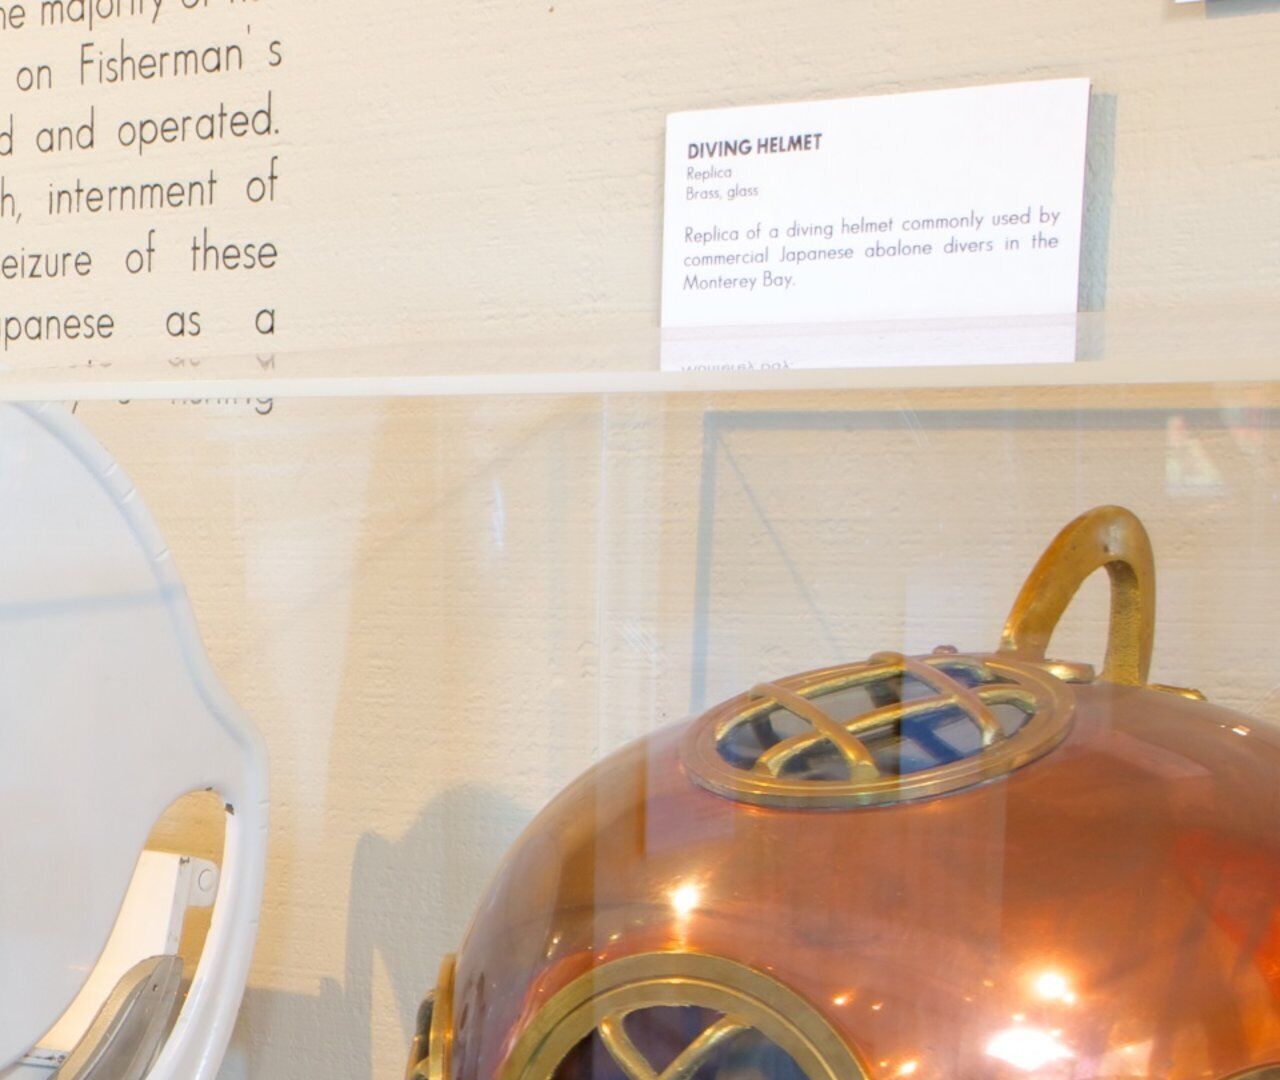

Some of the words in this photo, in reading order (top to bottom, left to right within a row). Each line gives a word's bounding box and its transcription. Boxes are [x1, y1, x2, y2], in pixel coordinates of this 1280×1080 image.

[16, 64, 52, 91] on
[35, 105, 94, 153] and
[117, 90, 279, 156] operated.
[687, 138, 753, 160] DIVING
[756, 132, 823, 154] HELMET
[48, 169, 217, 215] internment
[246, 155, 278, 203] of
[686, 165, 732, 182] Replica
[686, 186, 722, 202] Brass,
[727, 183, 758, 201] glass
[684, 224, 739, 245] Replica
[746, 222, 761, 239] of
[768, 227, 779, 238] a
[786, 220, 834, 239] diving
[840, 216, 893, 234] helmet
[901, 209, 984, 231] commonly
[992, 206, 1031, 226] used
[1039, 205, 1060, 226] by
[124, 229, 156, 274] of
[191, 227, 278, 271] these
[683, 246, 768, 267] commercial
[779, 246, 854, 264] Japanese
[864, 238, 933, 258] abalone
[943, 236, 993, 254] divers
[1004, 239, 1019, 250] in
[1031, 230, 1059, 249] the
[682, 274, 757, 291] Monterey
[762, 270, 795, 289] Bay.
[166, 308, 201, 336] as
[255, 308, 275, 335] a
